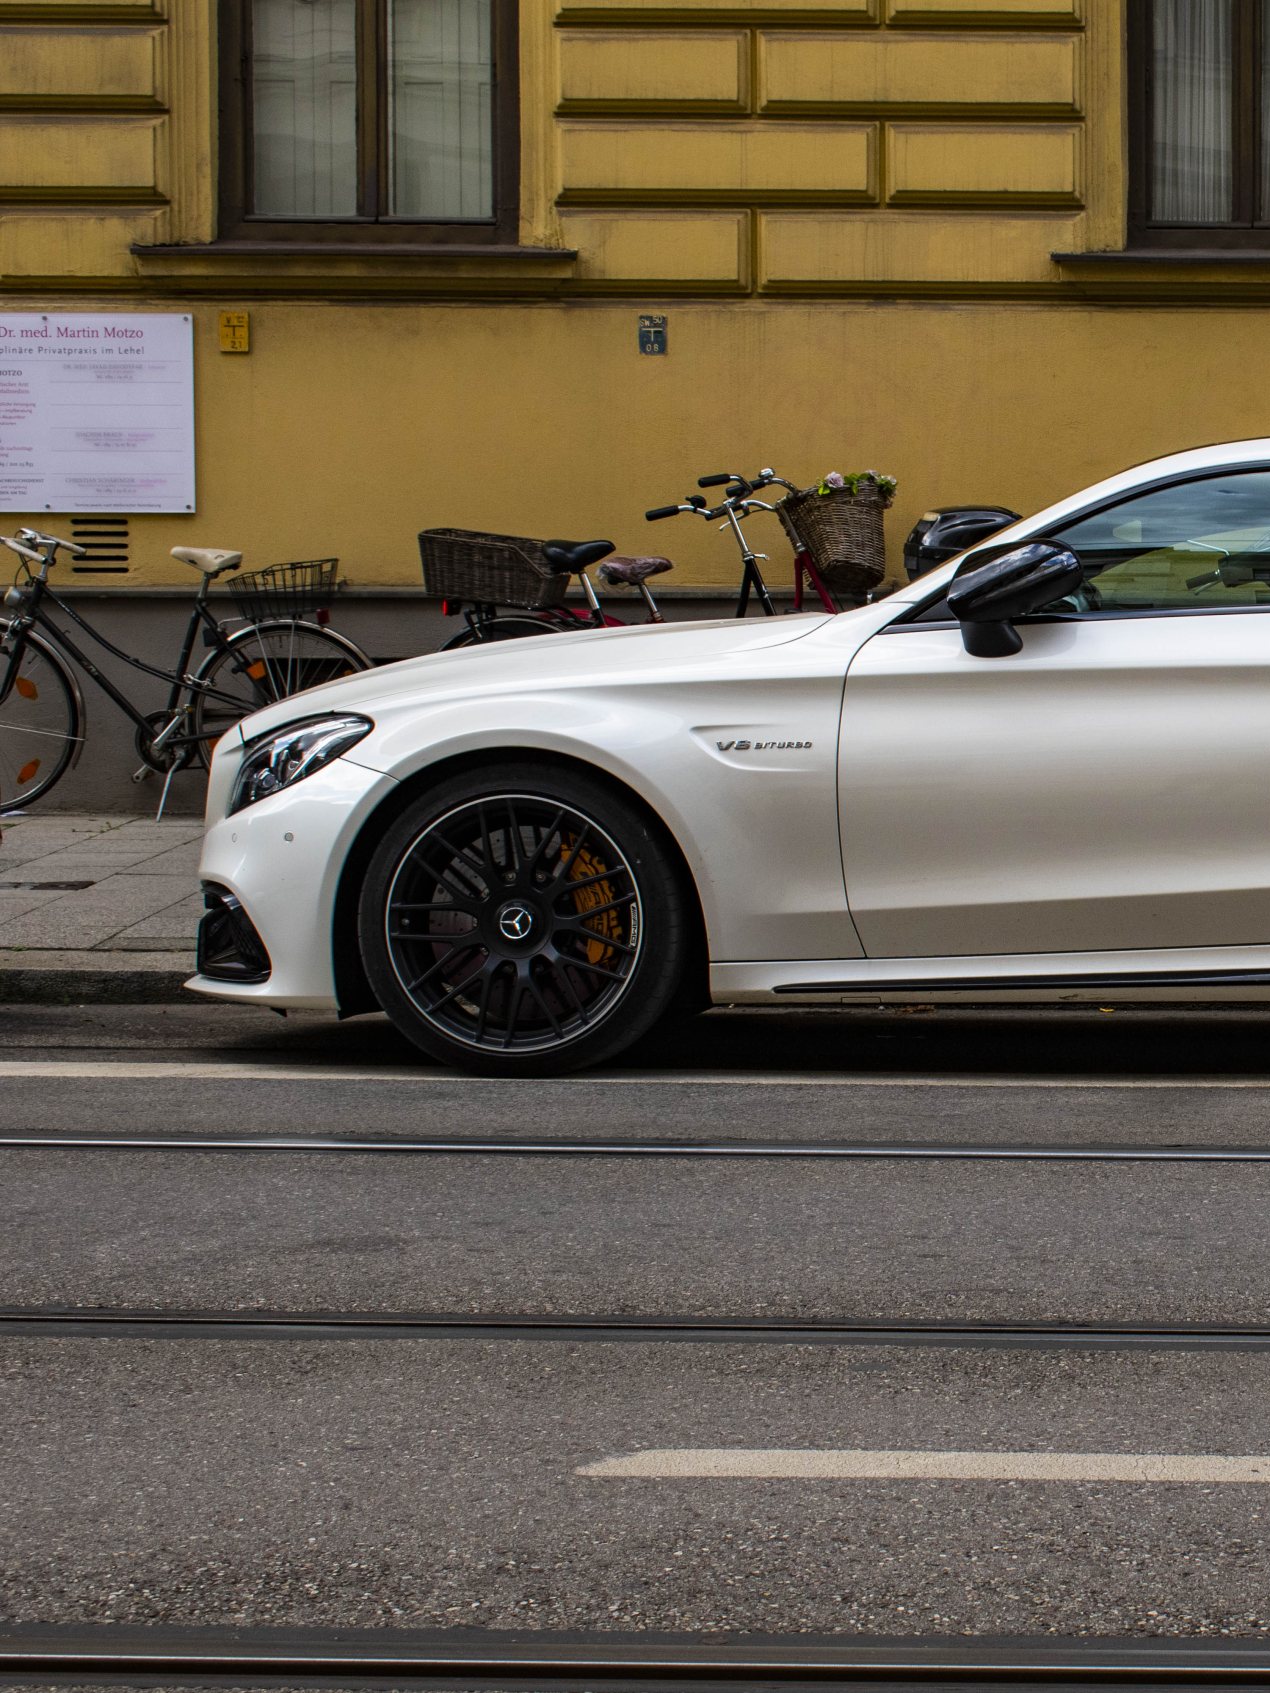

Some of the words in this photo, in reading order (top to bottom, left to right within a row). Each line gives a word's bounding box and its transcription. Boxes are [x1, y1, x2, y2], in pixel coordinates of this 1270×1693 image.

[20, 326, 52, 338] med.
[57, 327, 99, 338] Martin
[104, 327, 144, 338] Motzo
[38, 346, 97, 356] Privatpraxis
[102, 346, 113, 354] im
[118, 346, 145, 354] Lehel
